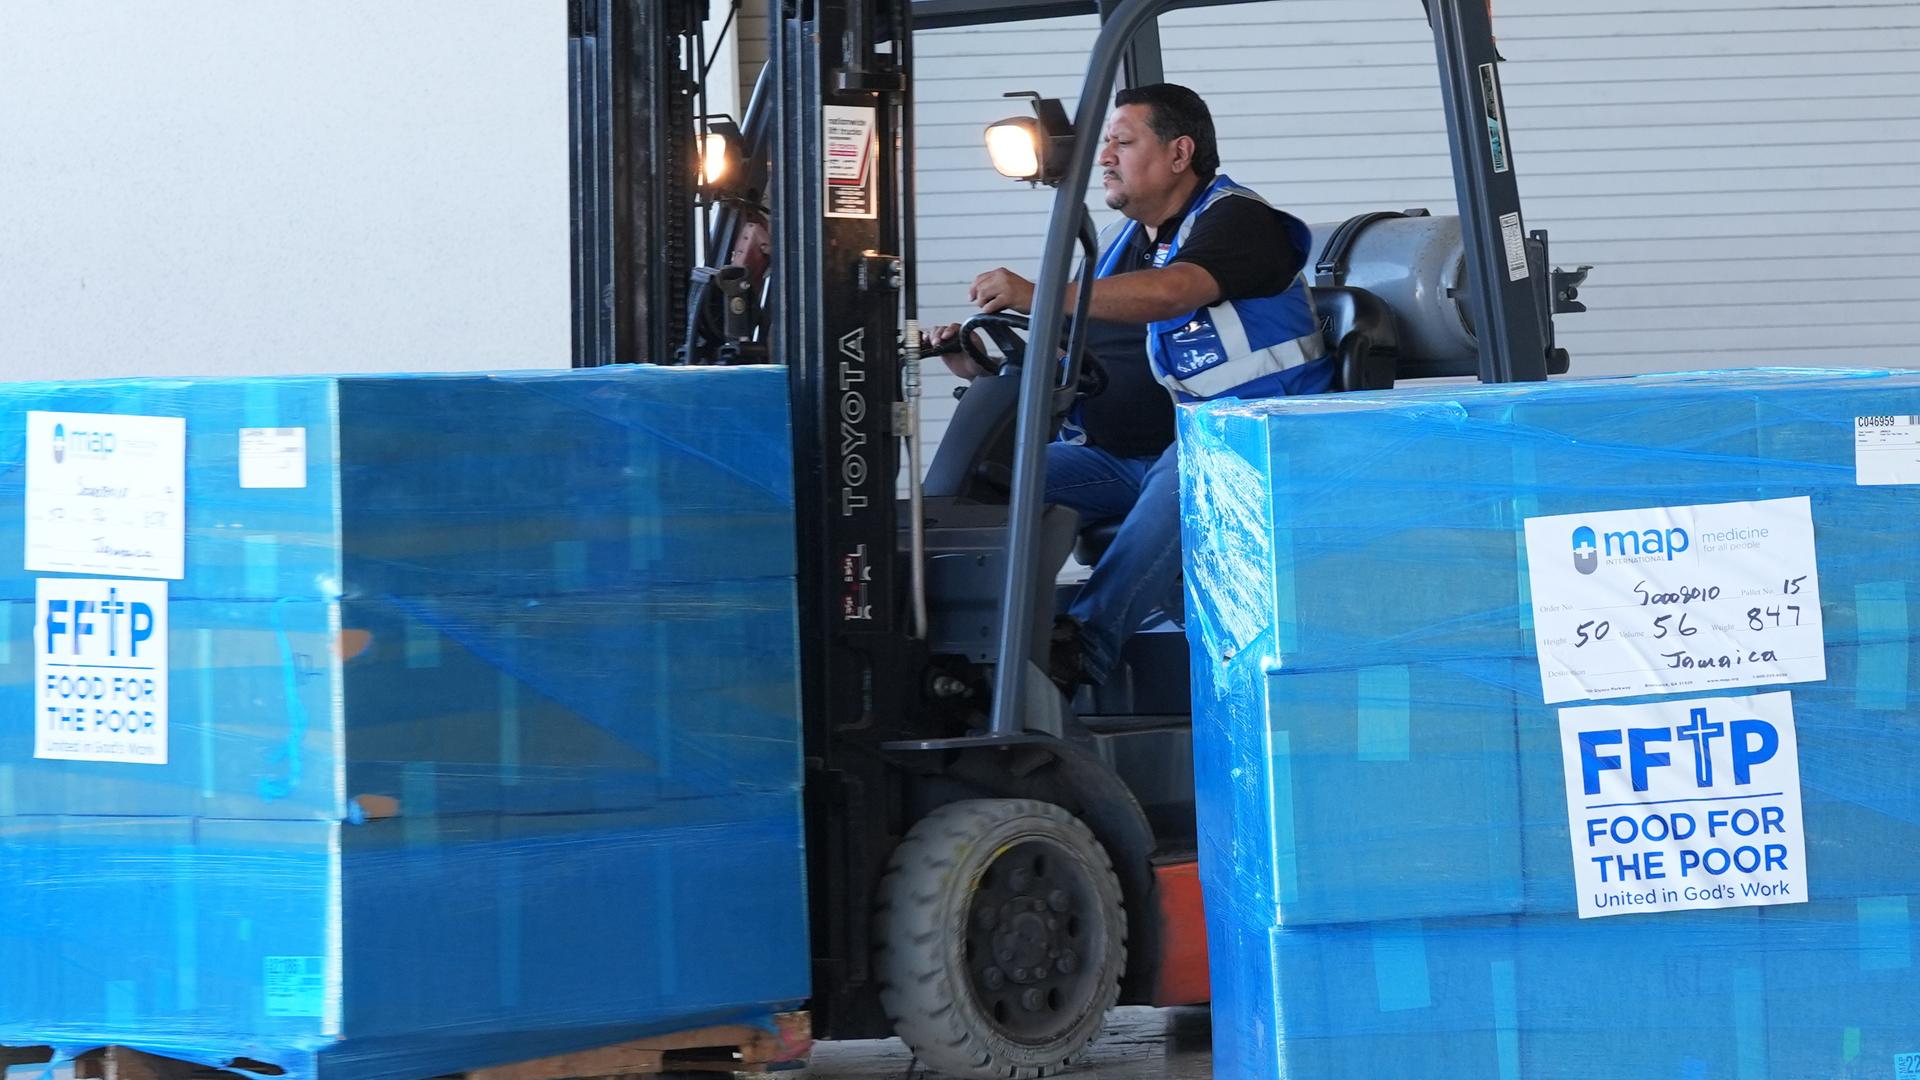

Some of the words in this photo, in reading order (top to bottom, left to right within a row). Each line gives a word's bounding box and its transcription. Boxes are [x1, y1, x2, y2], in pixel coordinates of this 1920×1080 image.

[839, 327, 868, 516] TOYOTA
[1858, 416, 1895, 427] C046959
[1604, 527, 1690, 561] map
[1702, 526, 1769, 543] medicine
[1703, 544, 1715, 553] for
[1718, 543, 1728, 552] all
[1730, 541, 1761, 552] people
[1606, 556, 1665, 566] INTERNATIONAL
[1784, 575, 1807, 594] 15
[1653, 613, 1697, 639] 56
[1711, 623, 1735, 633] Weight
[1747, 604, 1800, 631] 847
[1575, 620, 1610, 648] 50
[1619, 630, 1645, 639] Volume
[1660, 649, 1778, 669] Jamaica
[47, 675, 106, 700] FOOD
[113, 677, 157, 702] FOR
[47, 707, 85, 732] THE
[95, 708, 157, 735] POOR
[1586, 813, 1696, 847] FOOD
[1708, 806, 1786, 838] FOR
[1591, 852, 1666, 883] THE
[1680, 844, 1788, 877] POOR
[1594, 889, 1657, 908] United
[1663, 887, 1678, 903] in
[1684, 884, 1735, 902] God's
[1740, 880, 1790, 897] Work
